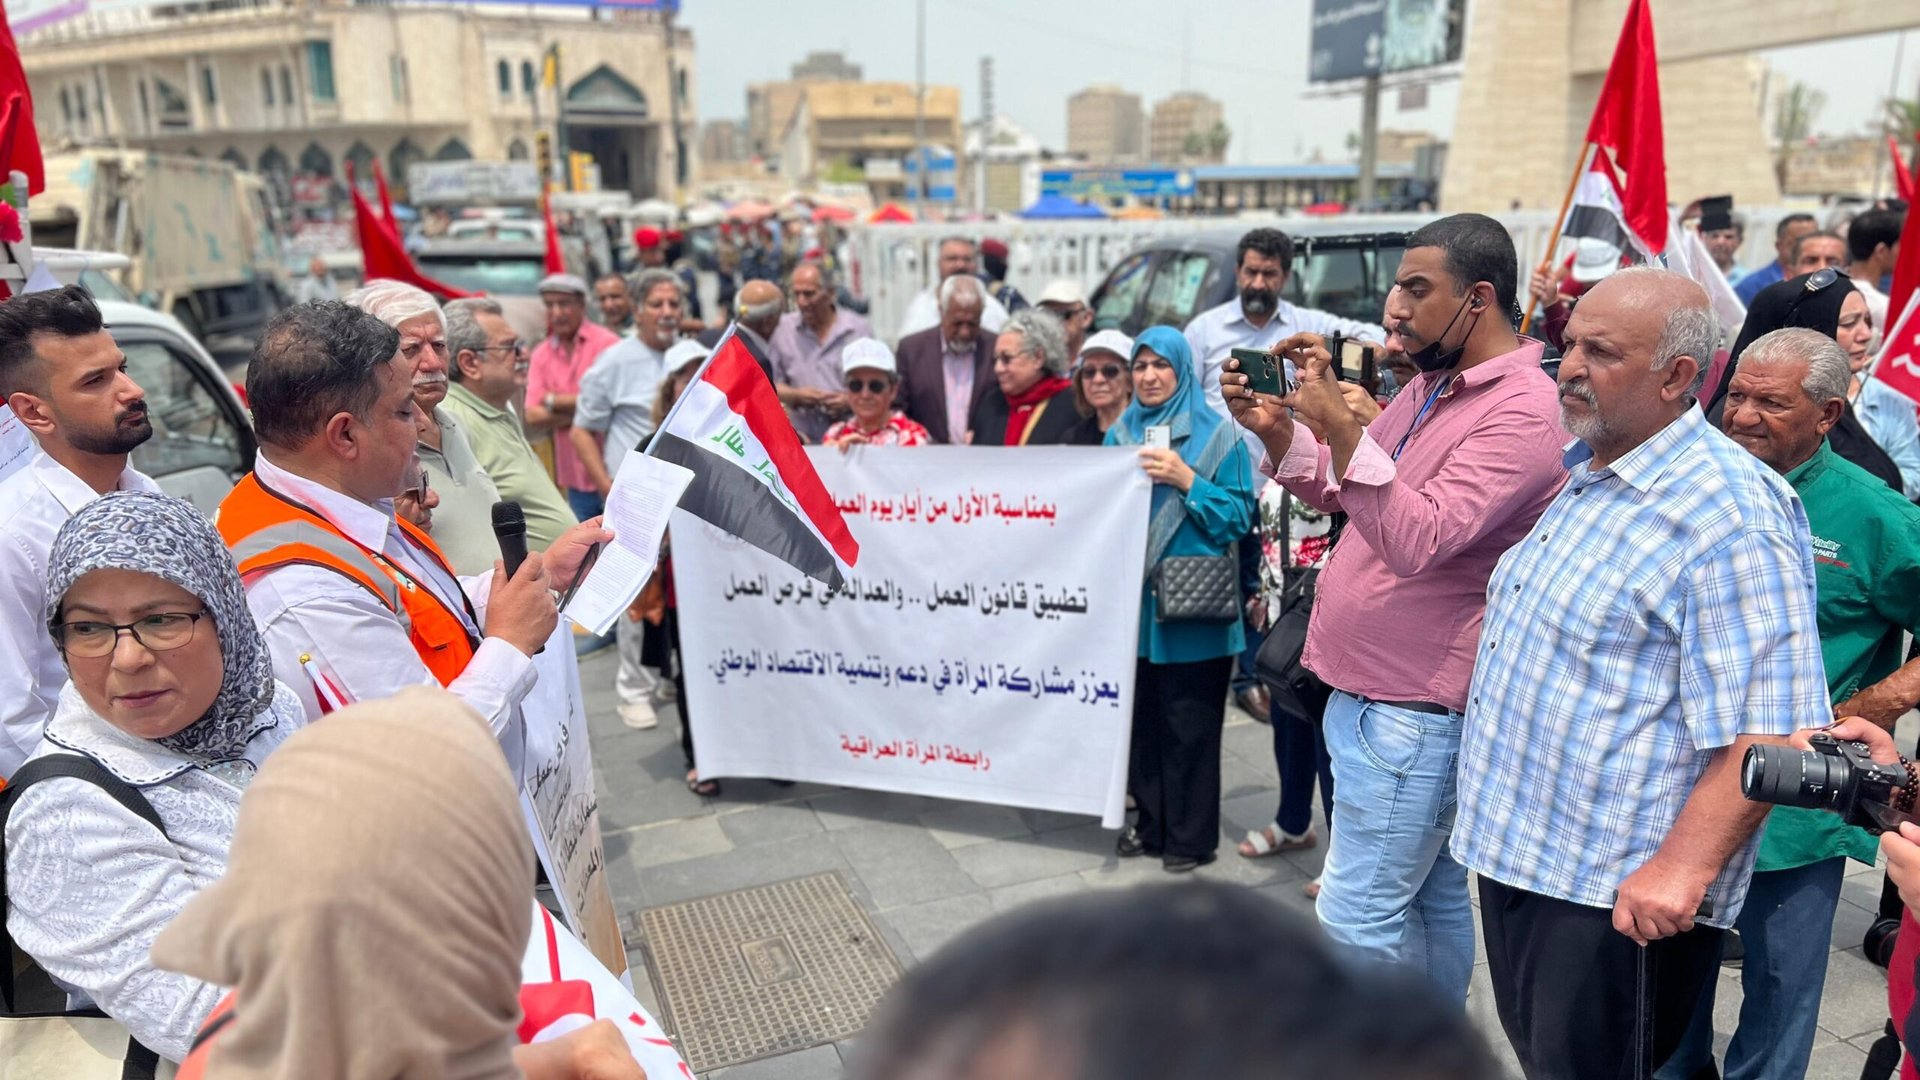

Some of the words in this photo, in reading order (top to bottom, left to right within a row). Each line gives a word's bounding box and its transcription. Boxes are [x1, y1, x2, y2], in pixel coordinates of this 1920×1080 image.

[871, 499, 893, 522] يوم
[896, 487, 922, 522] أيار
[926, 497, 947, 523] من
[952, 486, 988, 523] الأول
[992, 493, 1056, 526] بمناسبة
[724, 572, 769, 601] العمل
[774, 574, 812, 605] فرص
[926, 580, 975, 611] العمل
[980, 582, 1027, 615] قانون
[1034, 583, 1087, 620] تطبيق
[767, 649, 832, 675] الاقتصاد
[835, 652, 891, 687] وتنمية
[896, 665, 928, 688] دعم
[933, 659, 951, 695] في
[955, 657, 993, 694] المرأة
[997, 665, 1075, 698] مشاركة
[1080, 671, 1119, 707] يعزز
[840, 734, 903, 759] العراقية
[906, 739, 941, 764] المرأة
[944, 744, 991, 770] رابطة
